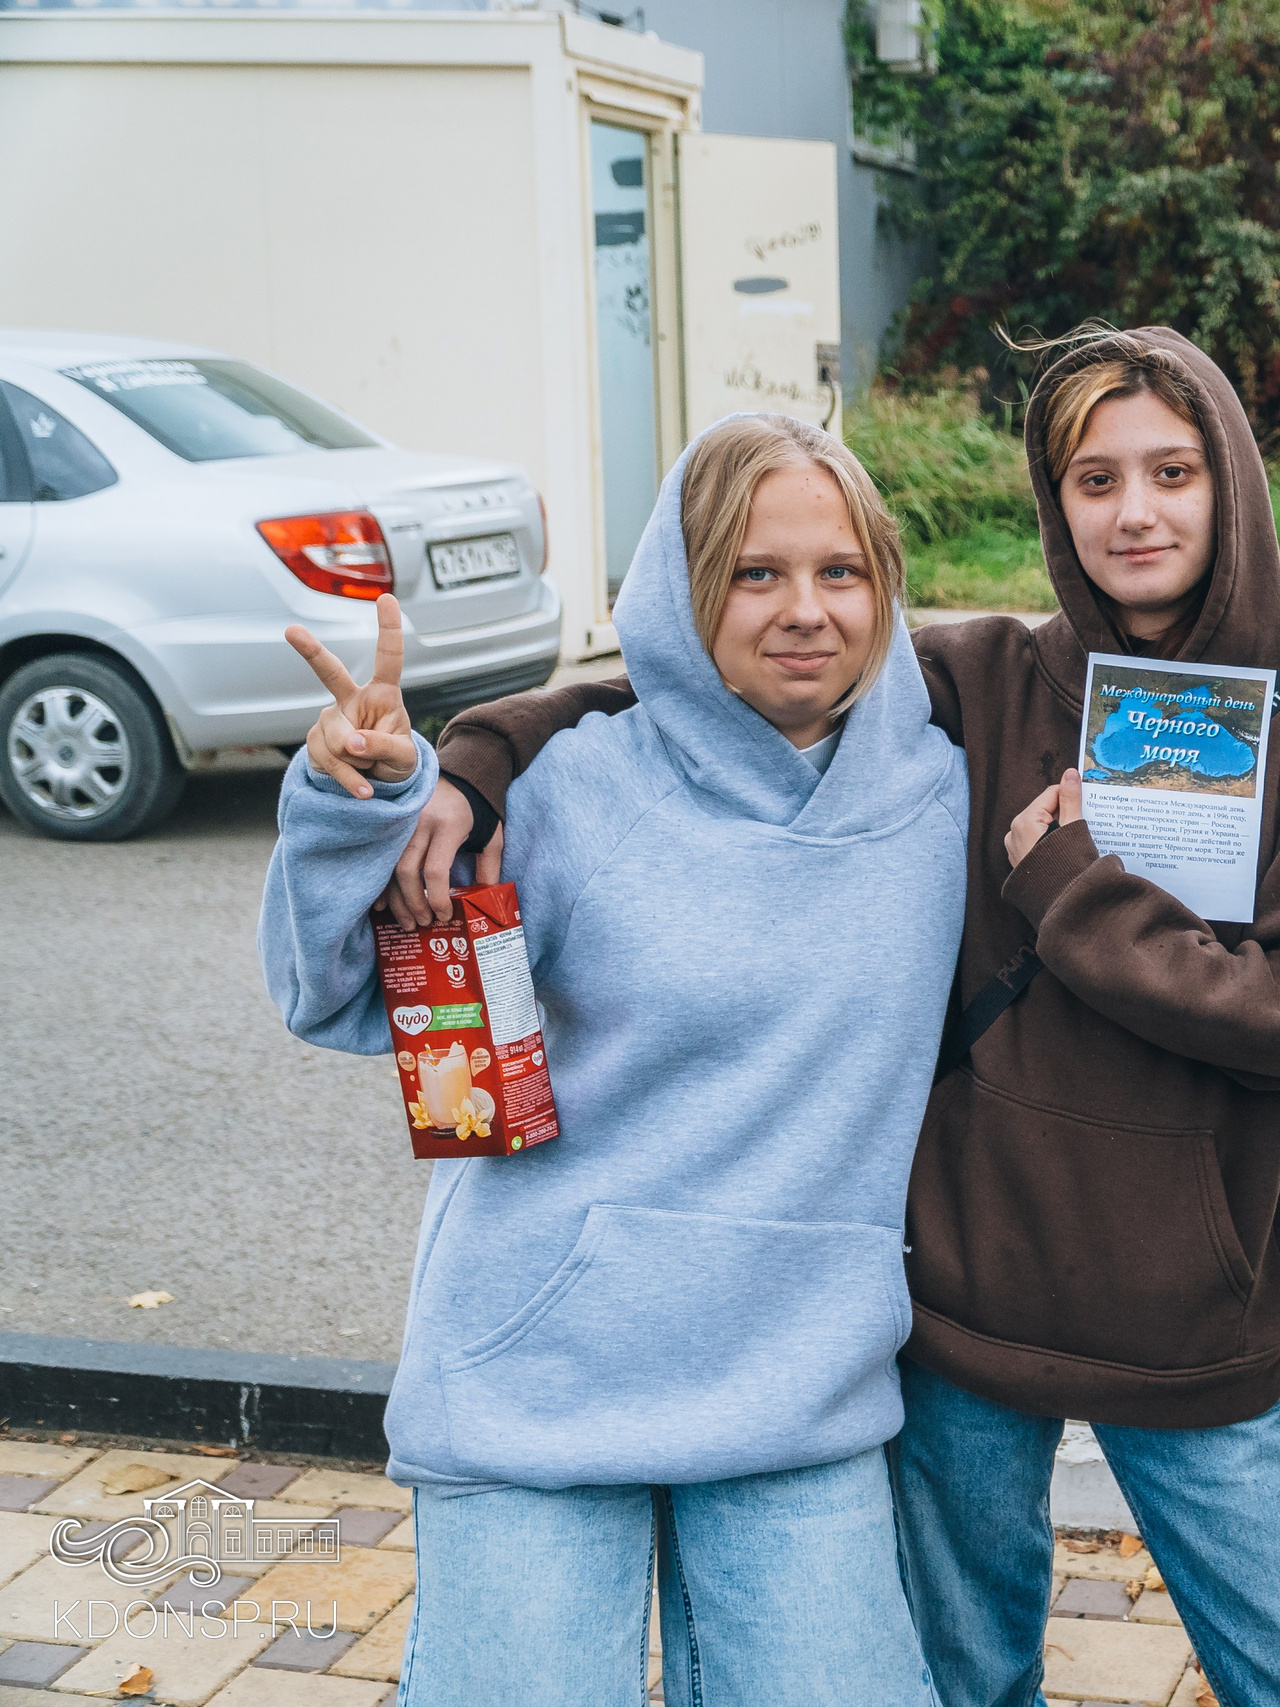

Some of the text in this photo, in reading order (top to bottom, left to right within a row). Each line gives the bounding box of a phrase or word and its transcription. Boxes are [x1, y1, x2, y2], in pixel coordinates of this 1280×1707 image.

[1100, 684, 1221, 707] Международный
[1224, 696, 1256, 711] день
[1127, 710, 1220, 738] Черного
[1140, 744, 1200, 767] моря
[1087, 801, 1114, 810] Чёрного
[1116, 804, 1135, 812] моря.
[1137, 805, 1164, 814] Именно
[1099, 794, 1129, 803] октября
[1131, 797, 1168, 806] отмечается
[1170, 800, 1227, 812] Международный
[1117, 814, 1178, 824] причерноморских
[1086, 819, 1114, 828] олгария,
[1116, 822, 1149, 831] Румыния,
[1151, 826, 1177, 834] Турция,
[1180, 827, 1203, 836] Грузия
[1211, 830, 1240, 838] Украина
[1125, 831, 1180, 842] Стратегический
[1200, 838, 1231, 846] действий
[1137, 852, 1167, 860] учредить
[1186, 855, 1236, 864] экологический
[1164, 844, 1193, 853] Чёрного
[1215, 848, 1234, 856] Тогда
[1145, 861, 1178, 870] праздник.
[397, 1012, 428, 1029] Чудо
